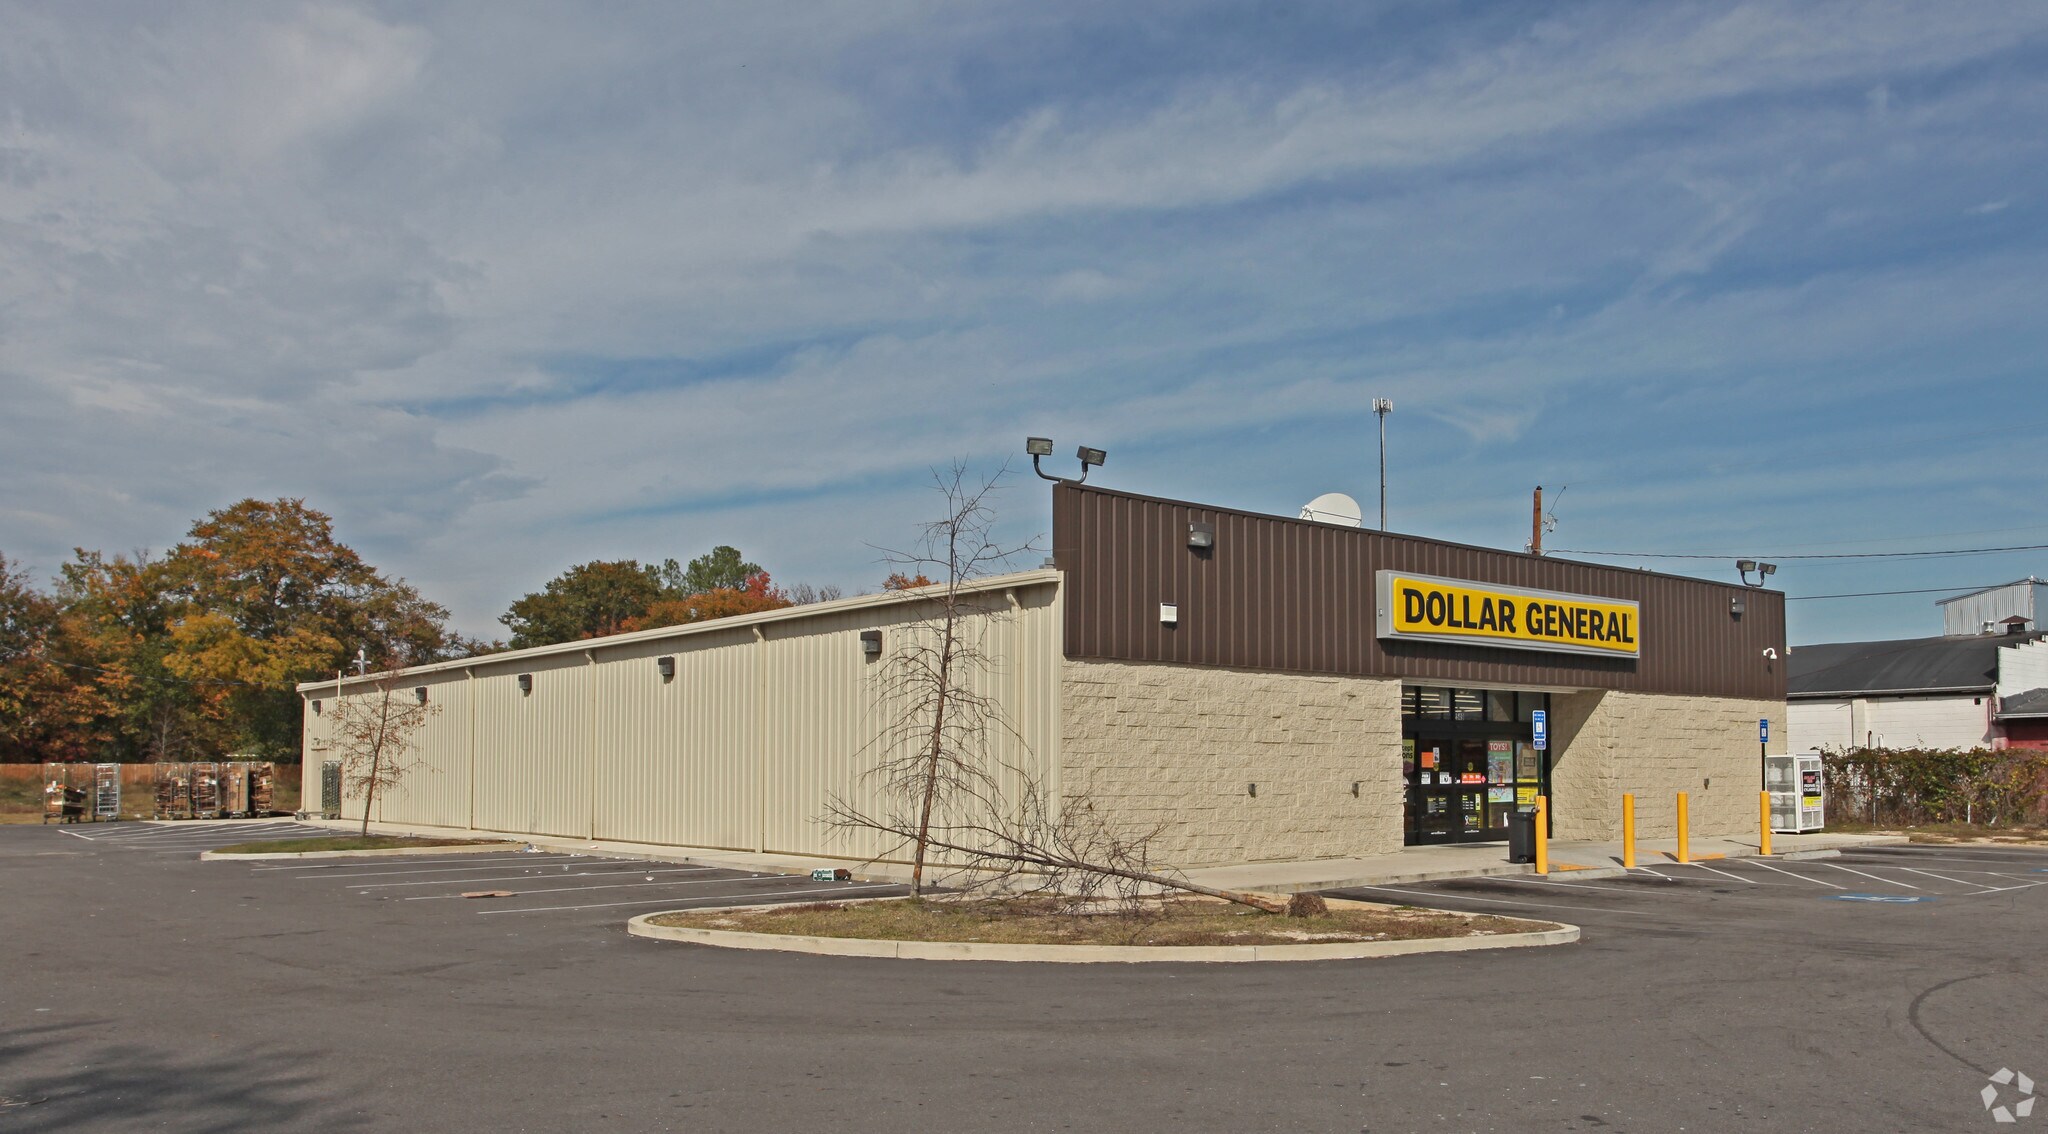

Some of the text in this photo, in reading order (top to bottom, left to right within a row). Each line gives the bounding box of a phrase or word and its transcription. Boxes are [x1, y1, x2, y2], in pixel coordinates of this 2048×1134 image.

[1403, 588, 1633, 643] DOLLAR GENERAL
[1489, 742, 1508, 751] TOYS!
